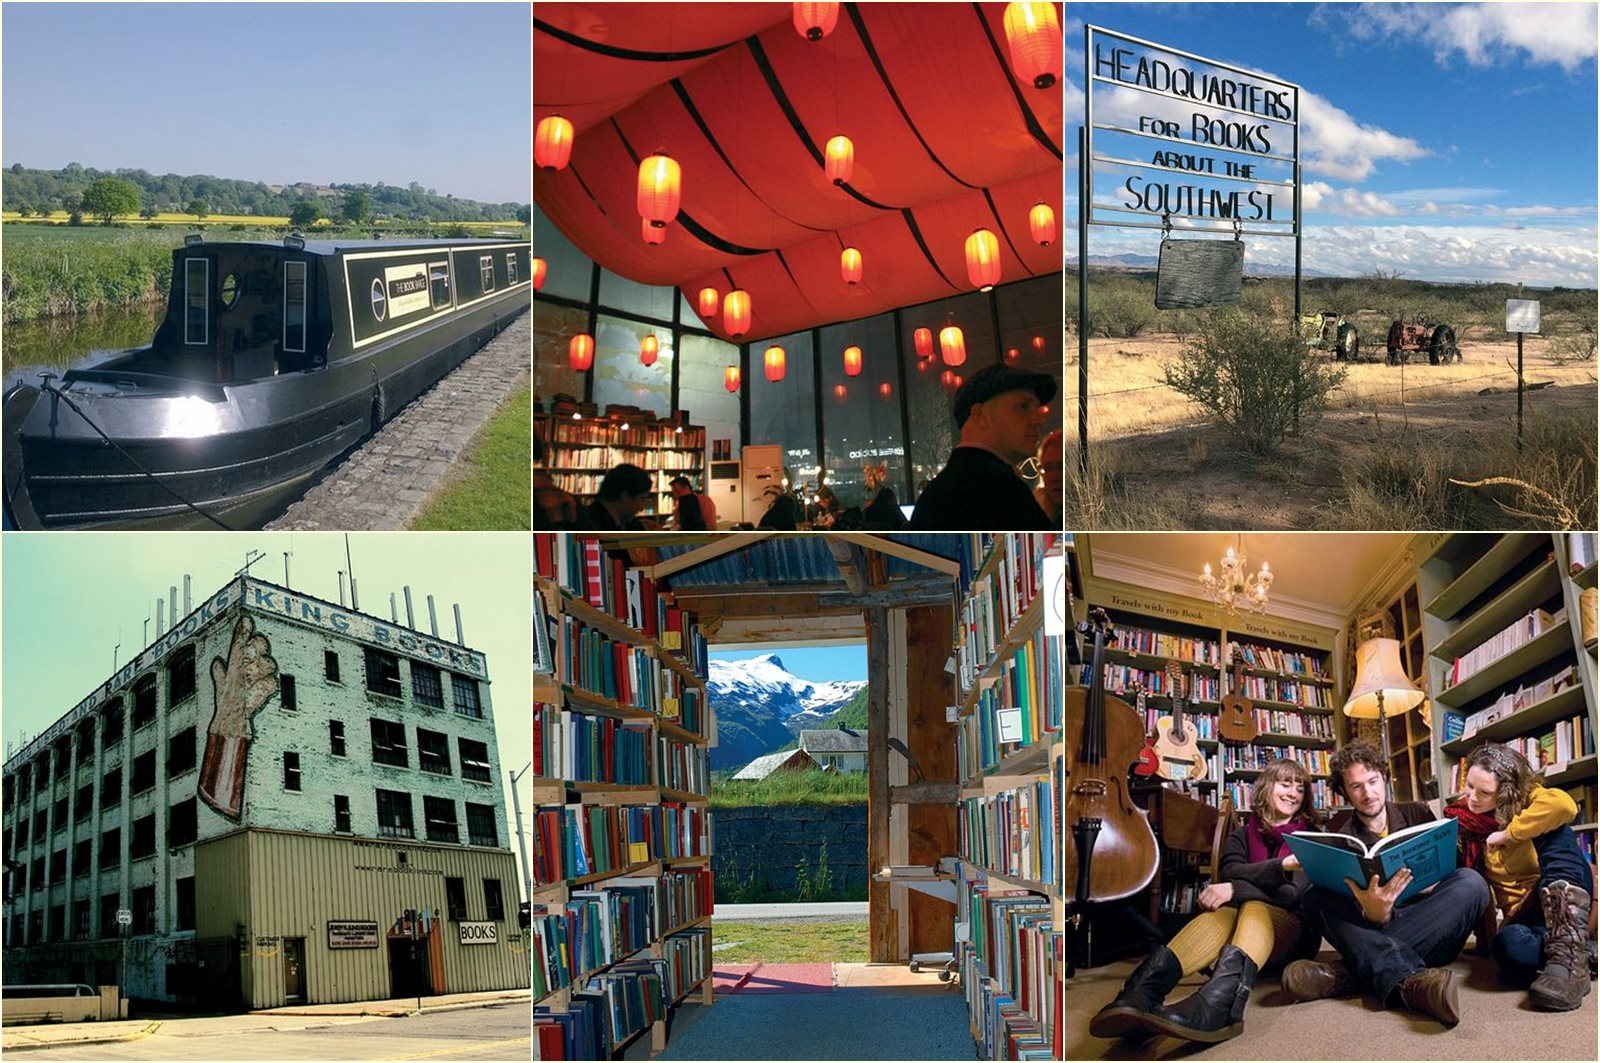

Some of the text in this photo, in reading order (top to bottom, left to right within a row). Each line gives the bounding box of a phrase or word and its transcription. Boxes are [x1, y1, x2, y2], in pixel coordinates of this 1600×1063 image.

[1095, 43, 1292, 121] HEADQUARTERS
[1139, 113, 1272, 154] FOR BOOKS
[1152, 150, 1257, 179] ABOUT THE
[1124, 176, 1276, 221] SOUTHWEST
[254, 588, 351, 631] KING
[1111, 595, 1141, 609] Travels
[1144, 603, 1164, 613] with
[1166, 608, 1179, 617] my
[37, 720, 66, 749] USED
[71, 696, 97, 720] AND
[104, 656, 145, 698] RARE
[153, 590, 229, 660] BOOKS
[999, 708, 1022, 742] E
[461, 925, 496, 940] BOOKS
